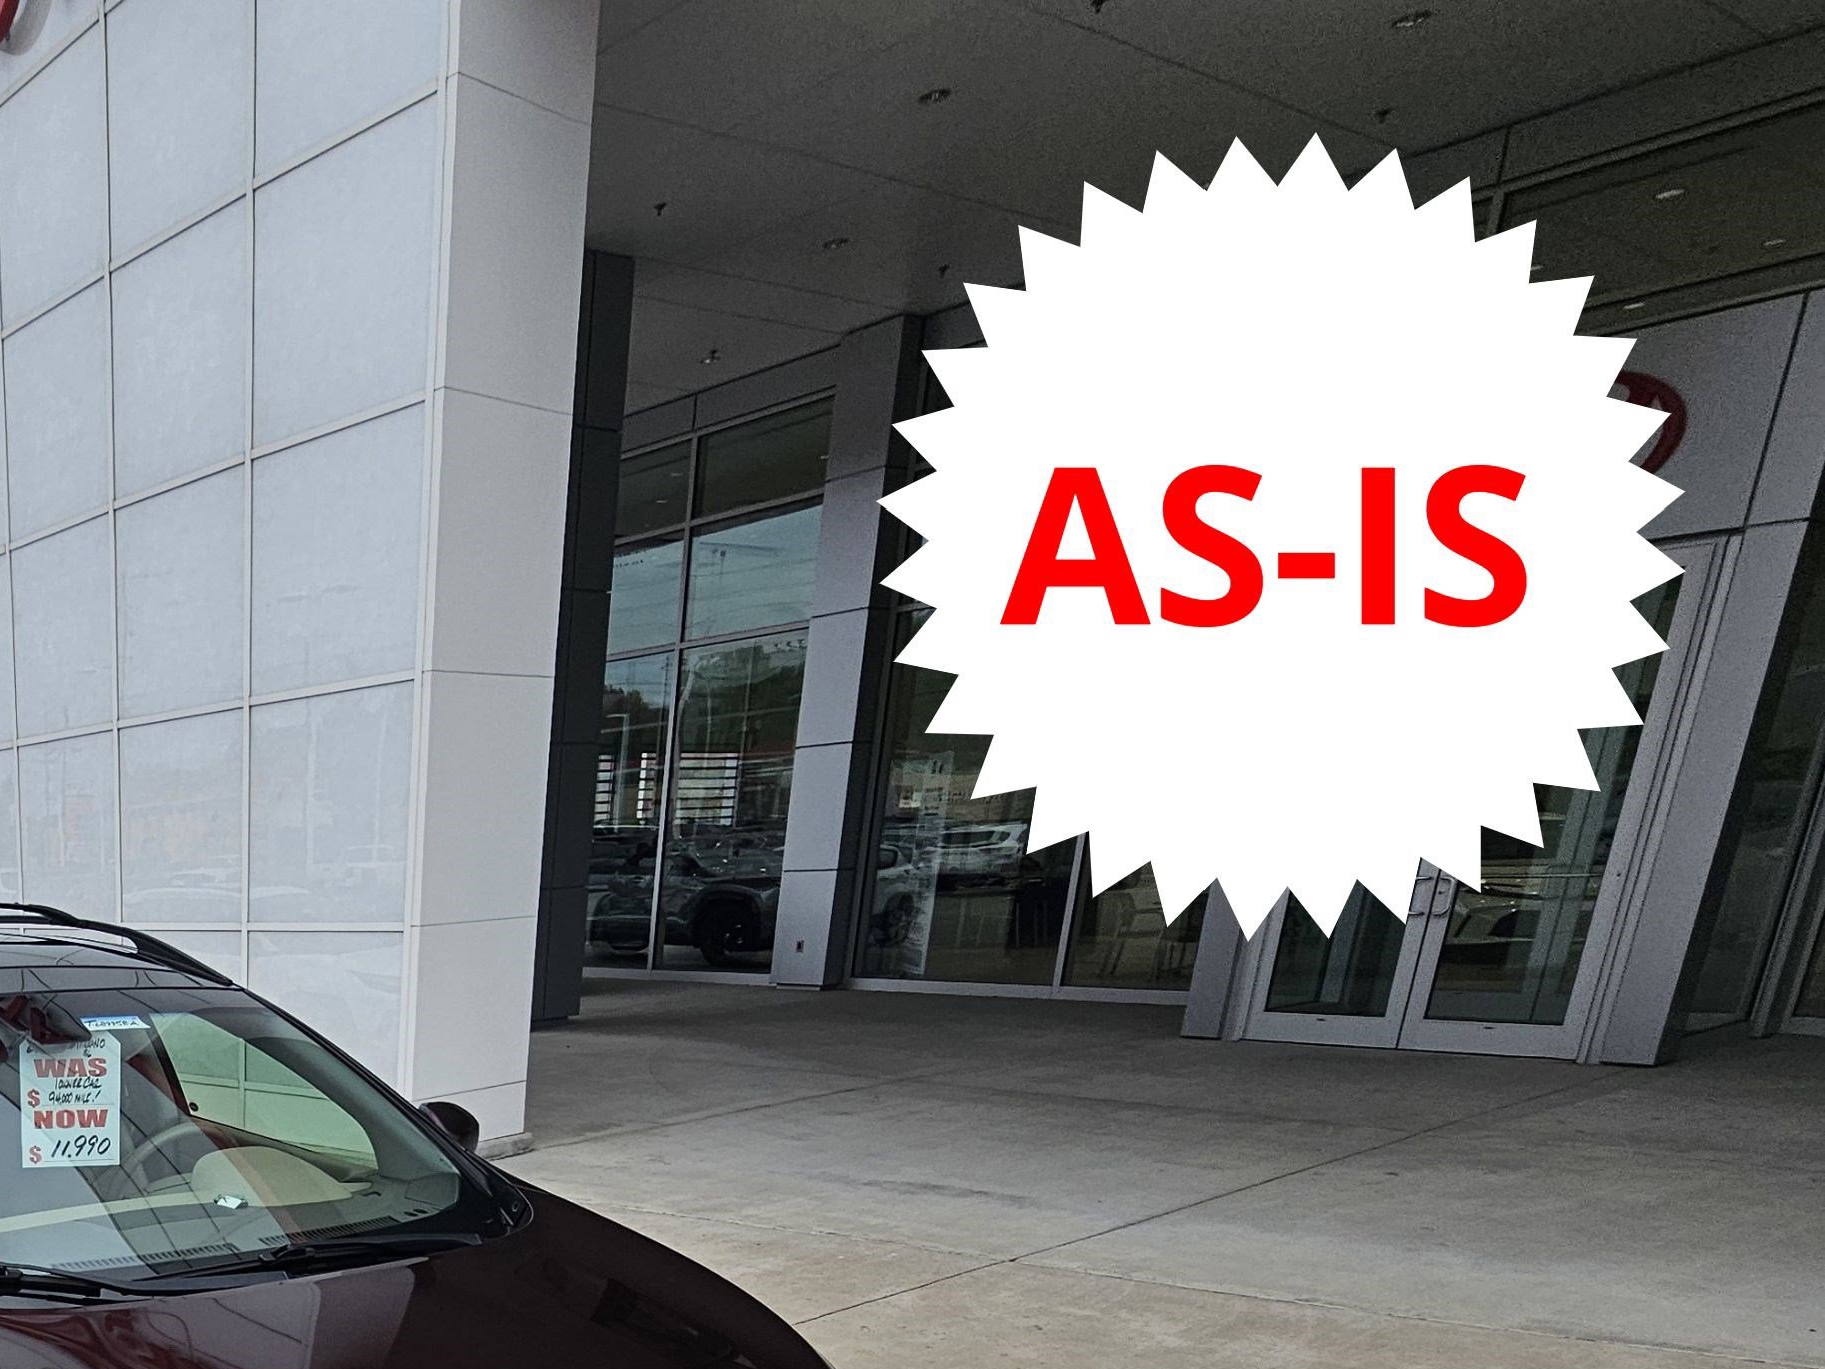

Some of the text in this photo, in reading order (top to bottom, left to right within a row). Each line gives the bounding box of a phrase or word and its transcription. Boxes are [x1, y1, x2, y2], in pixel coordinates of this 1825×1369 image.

[34, 1058, 107, 1078] WAS
[27, 1089, 41, 1108] $
[34, 1109, 108, 1129] NOW
[29, 1145, 42, 1165] $
